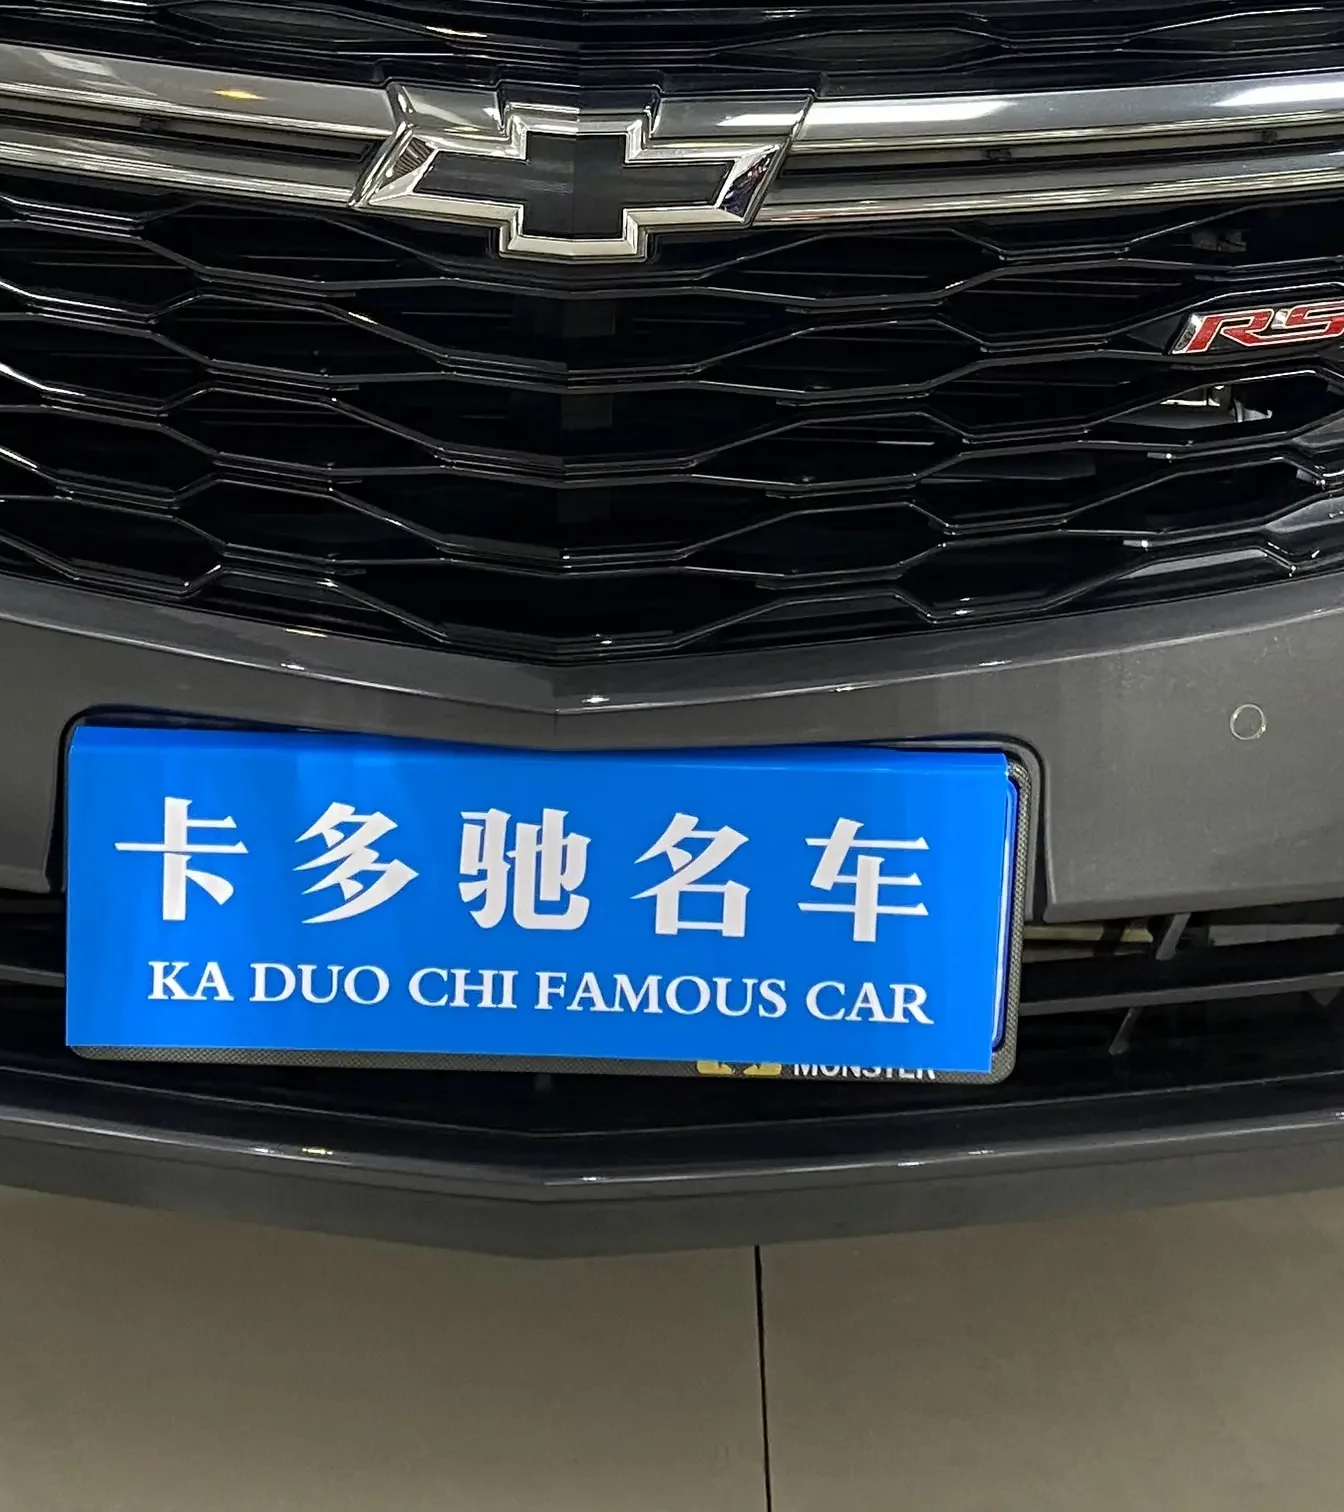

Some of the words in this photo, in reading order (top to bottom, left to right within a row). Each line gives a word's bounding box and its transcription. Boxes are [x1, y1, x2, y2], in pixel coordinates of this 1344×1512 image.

[115, 796, 930, 943] 卡多驰名车
[147, 961, 235, 1003] KA
[250, 965, 390, 1006] DUO
[408, 969, 518, 1010] CHI
[536, 973, 788, 1020] FAMOUS
[806, 981, 935, 1026] CAR
